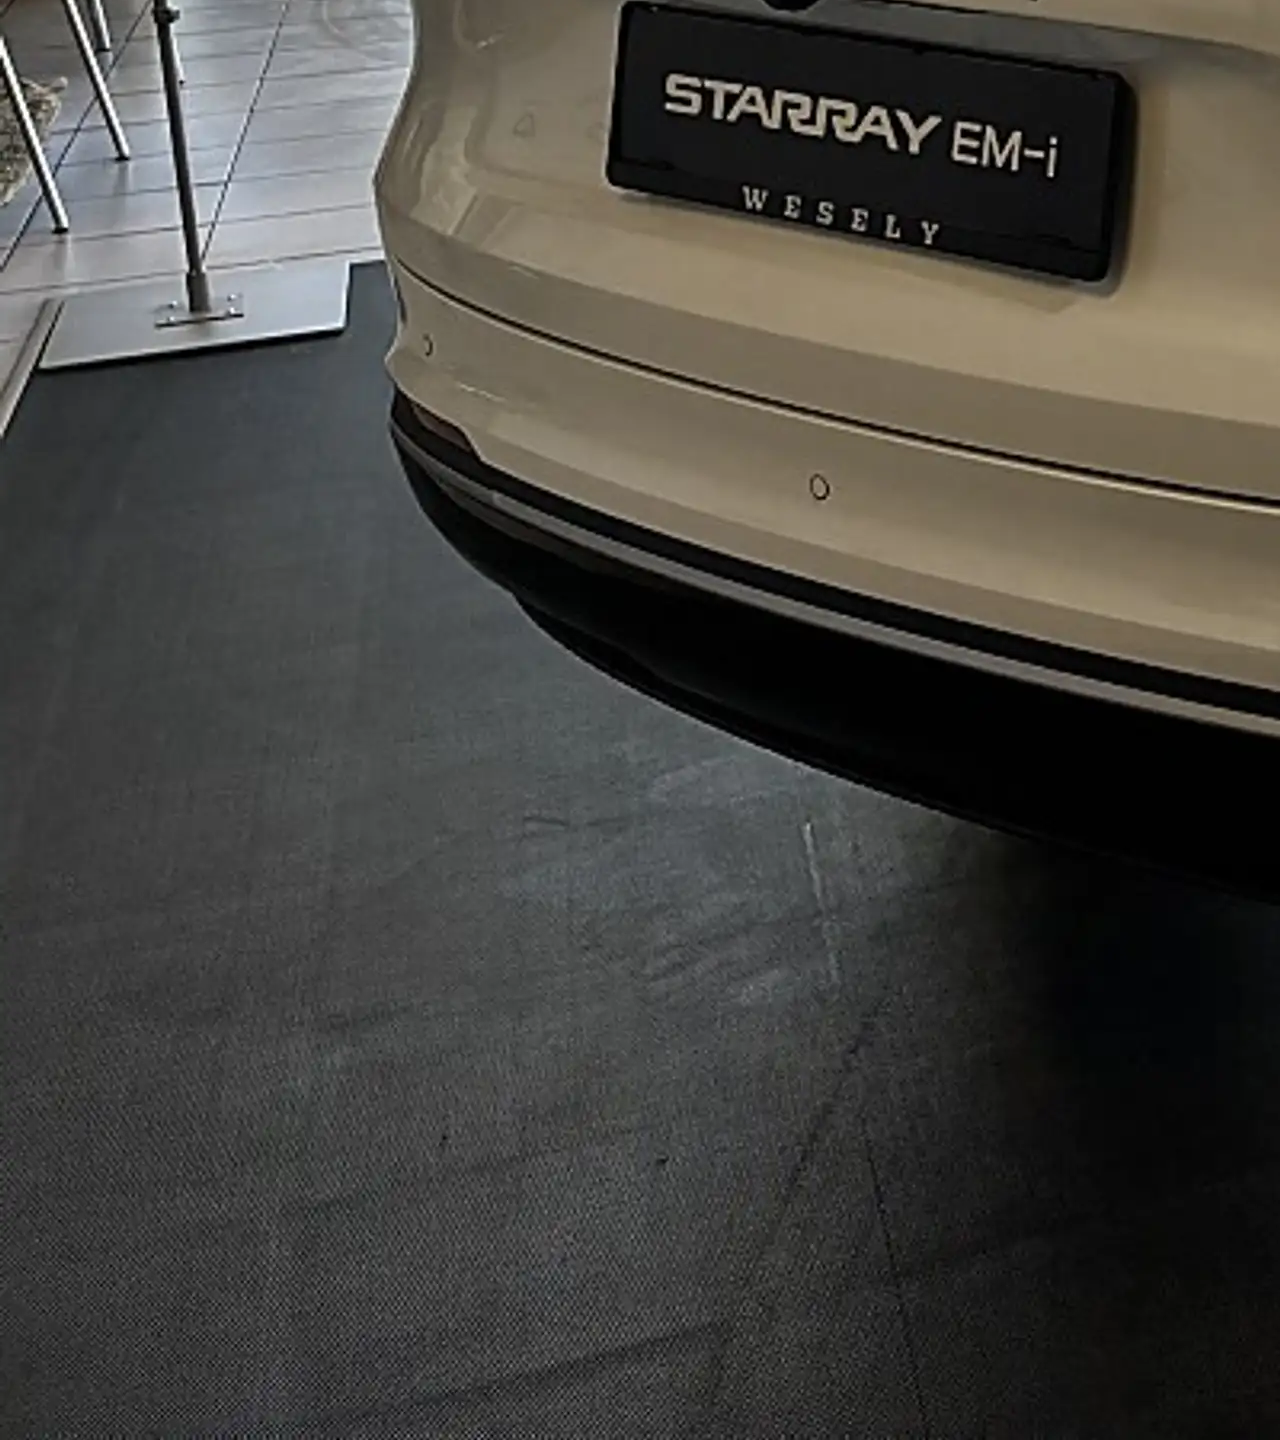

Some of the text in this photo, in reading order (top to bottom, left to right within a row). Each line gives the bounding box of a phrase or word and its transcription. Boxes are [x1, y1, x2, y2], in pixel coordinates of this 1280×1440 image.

[663, 72, 1060, 179] STARRAY EM-i
[742, 184, 942, 246] WESELY
